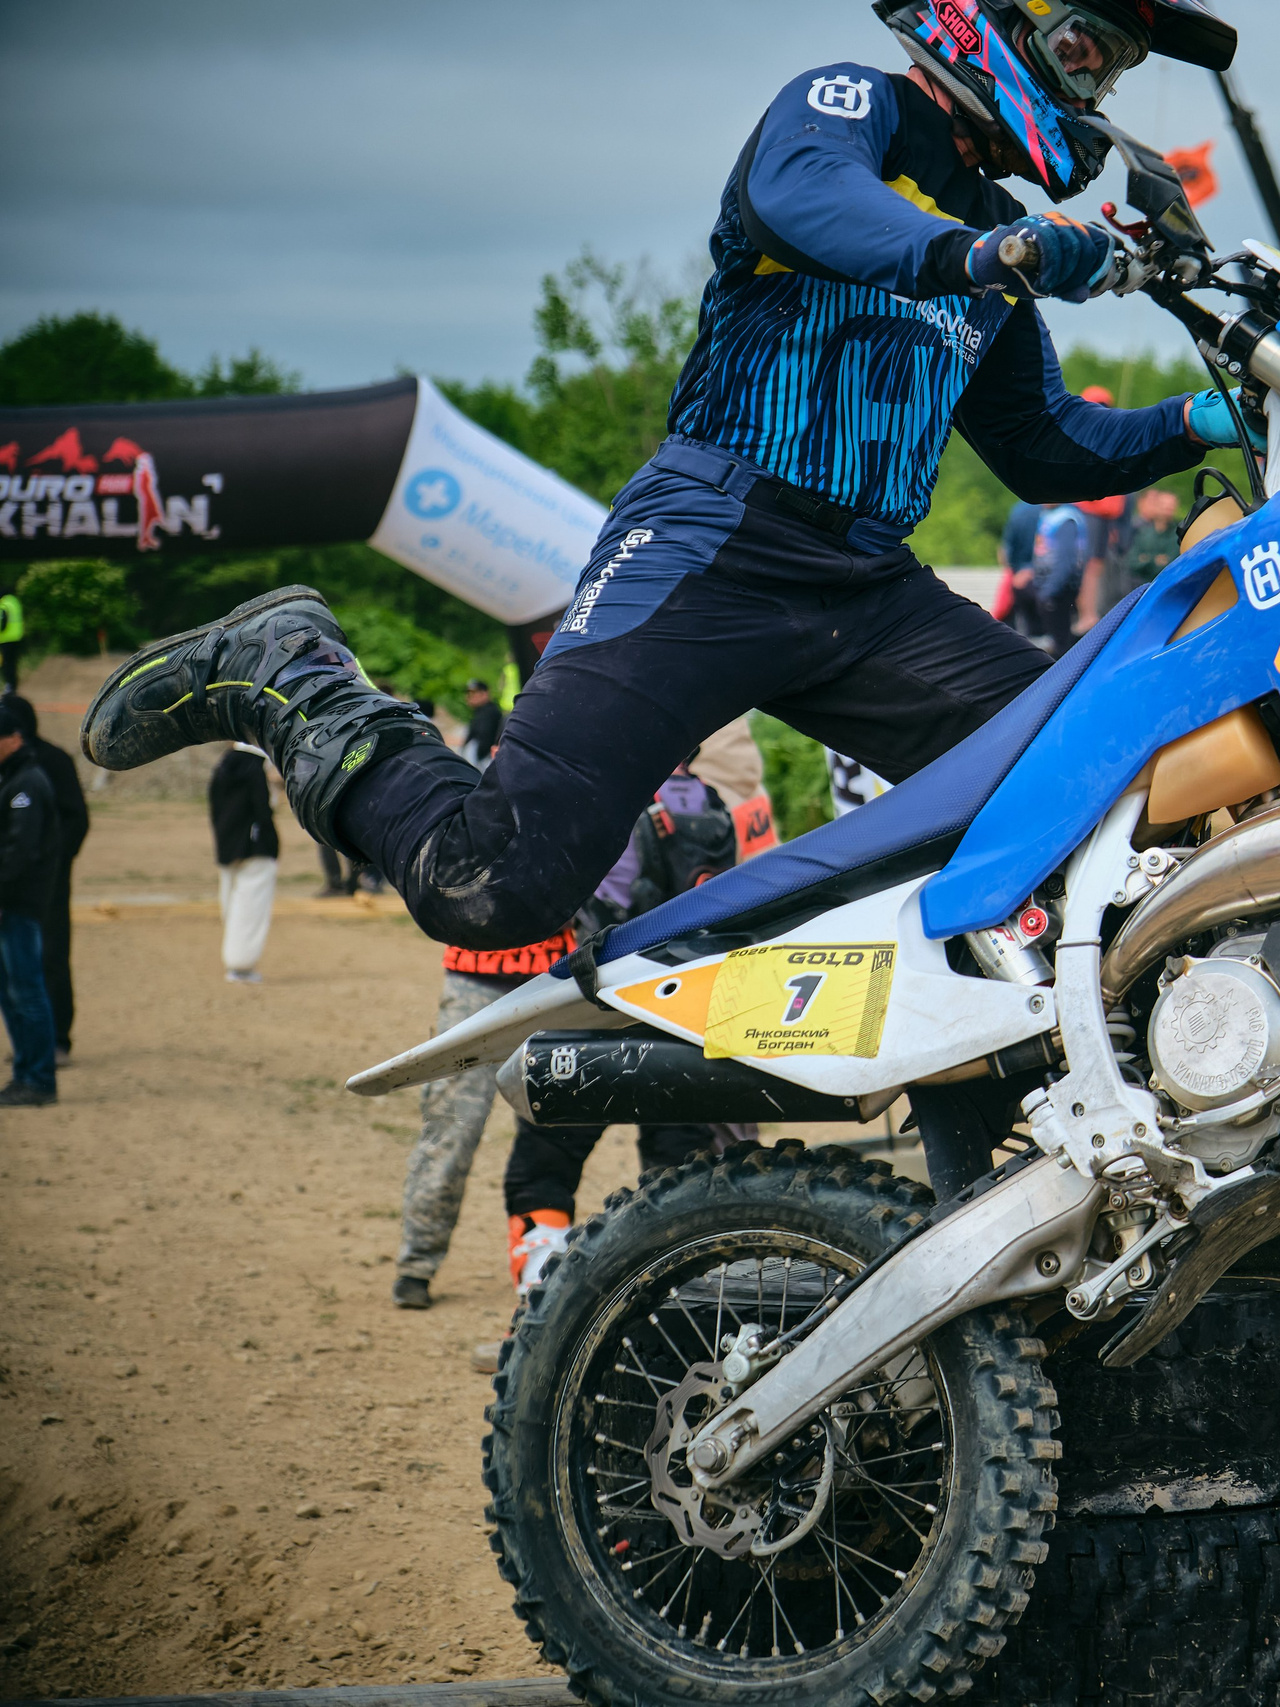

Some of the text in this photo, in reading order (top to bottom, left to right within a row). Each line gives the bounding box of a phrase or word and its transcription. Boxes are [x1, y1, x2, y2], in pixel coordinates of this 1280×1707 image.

[940, 5, 978, 50] SHOEI
[0, 473, 96, 501] URO
[787, 951, 865, 968] GOLD
[784, 975, 823, 1022] 1
[744, 1028, 830, 1039] Янковский
[757, 1040, 815, 1051] Богдан
